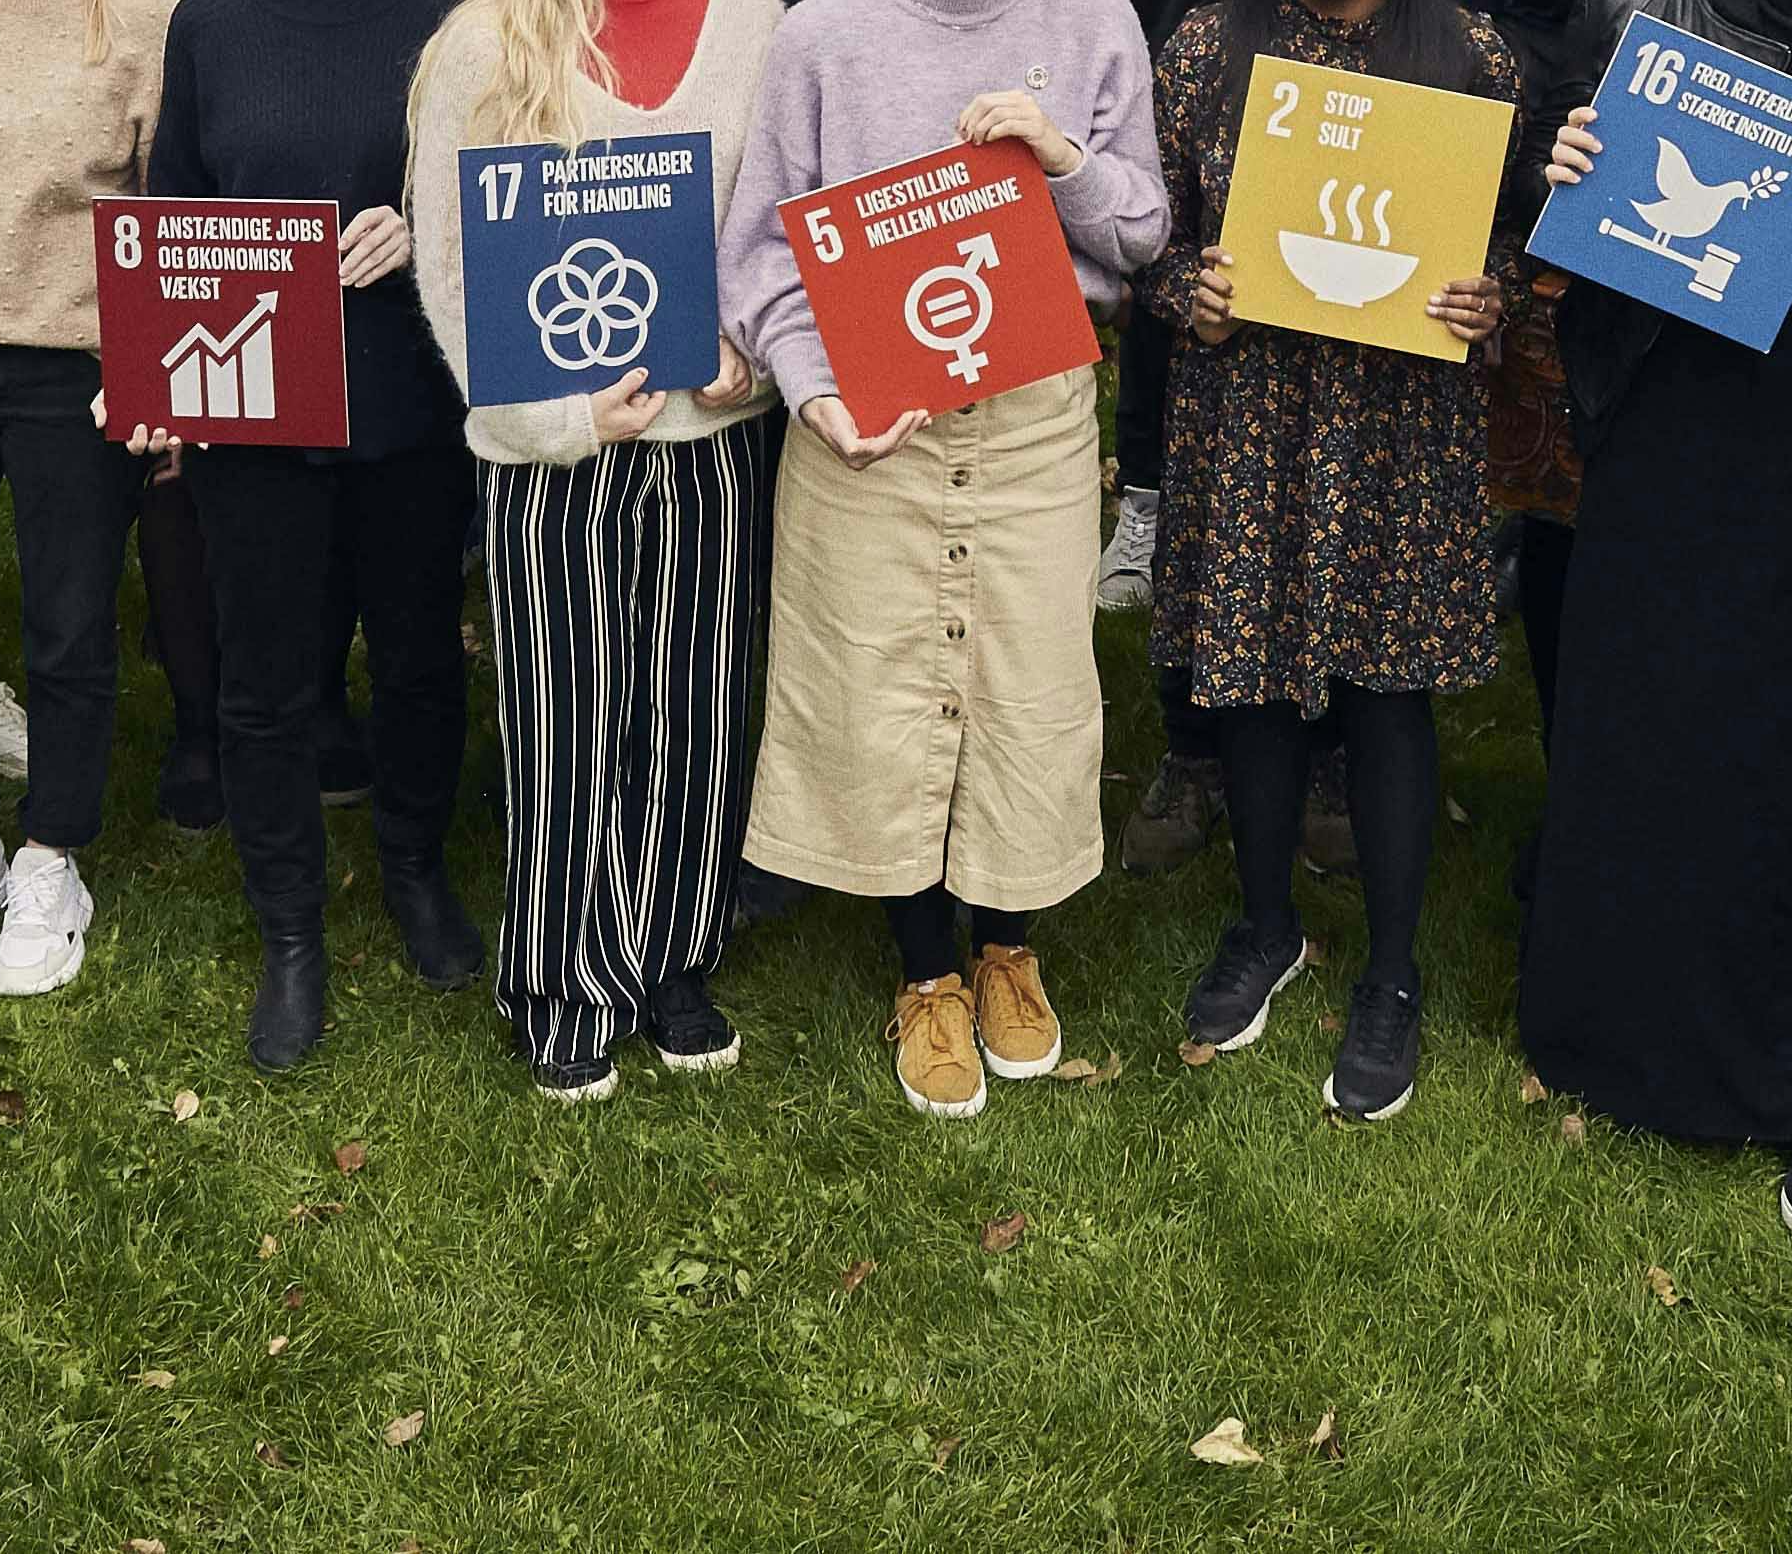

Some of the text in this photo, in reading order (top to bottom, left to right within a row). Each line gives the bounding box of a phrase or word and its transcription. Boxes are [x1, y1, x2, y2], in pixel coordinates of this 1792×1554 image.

[1628, 42, 1686, 105] 16
[1690, 62, 1729, 96] FRED,
[1266, 81, 1300, 138] 2
[1324, 90, 1373, 121] STOP
[1678, 93, 1738, 132] STÆRKE
[1318, 121, 1363, 151] SULT
[542, 149, 694, 185] PARTNERSKABER
[478, 162, 523, 222] 17
[543, 183, 672, 217] FOR HANDLING
[855, 162, 971, 219] LIGESTILLING
[157, 216, 324, 242] ANSTÆNDIGE JOBS
[864, 176, 1023, 249] MELLEM KØNNENE
[114, 215, 143, 269] 8
[804, 206, 845, 264] 5
[158, 246, 294, 272] OG ØKONOMISK
[160, 276, 222, 300] VÆKST
